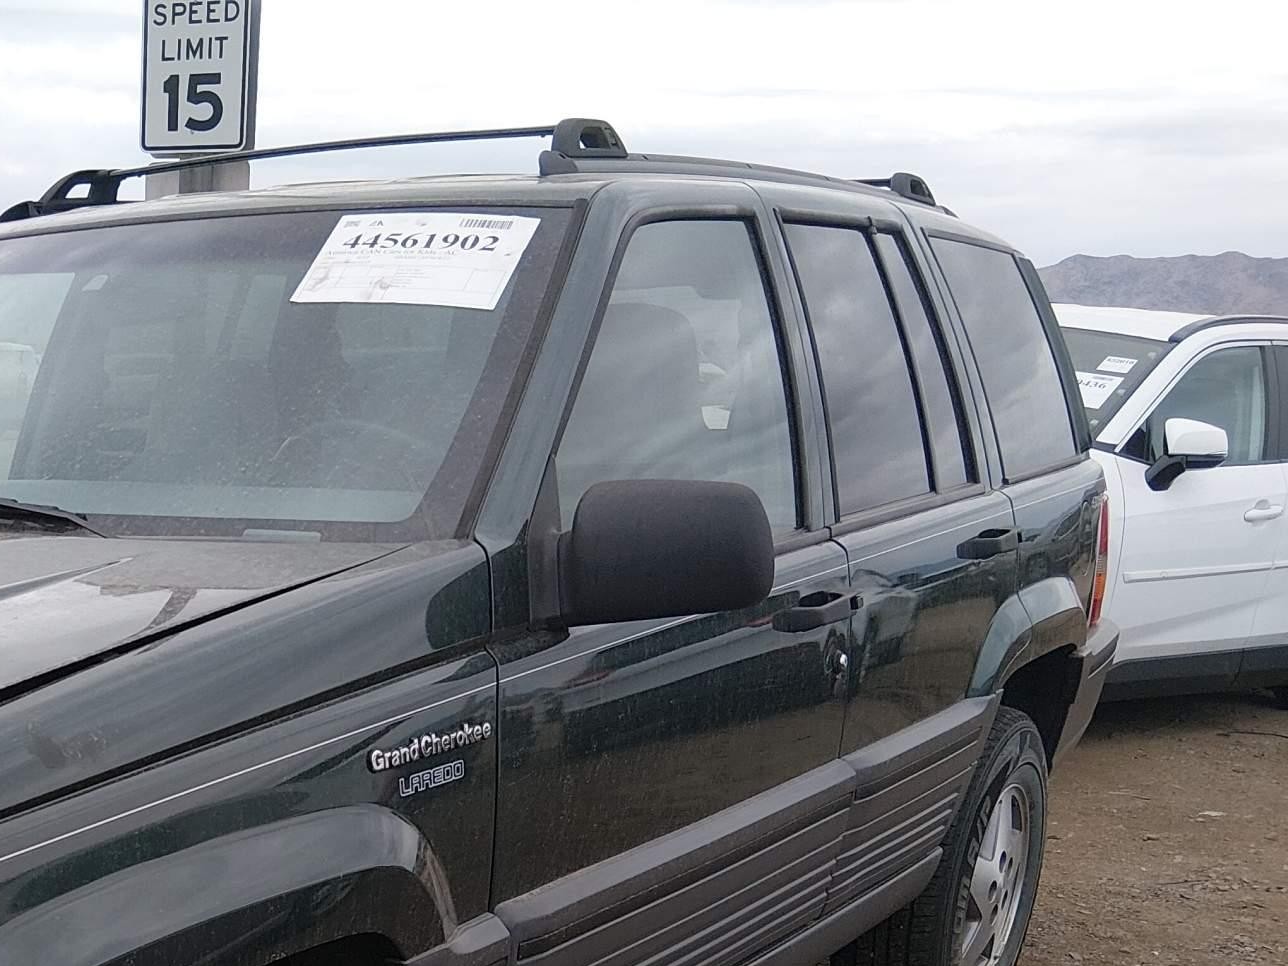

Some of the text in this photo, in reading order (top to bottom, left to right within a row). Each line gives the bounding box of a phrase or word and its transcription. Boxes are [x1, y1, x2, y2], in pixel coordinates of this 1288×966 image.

[152, 0, 241, 26] SPEED
[160, 36, 229, 62] LIMIT
[163, 72, 224, 133] 15
[343, 232, 500, 252] 44561902
[371, 722, 492, 771] Grand Cherokee
[399, 759, 465, 797] LAREDO
